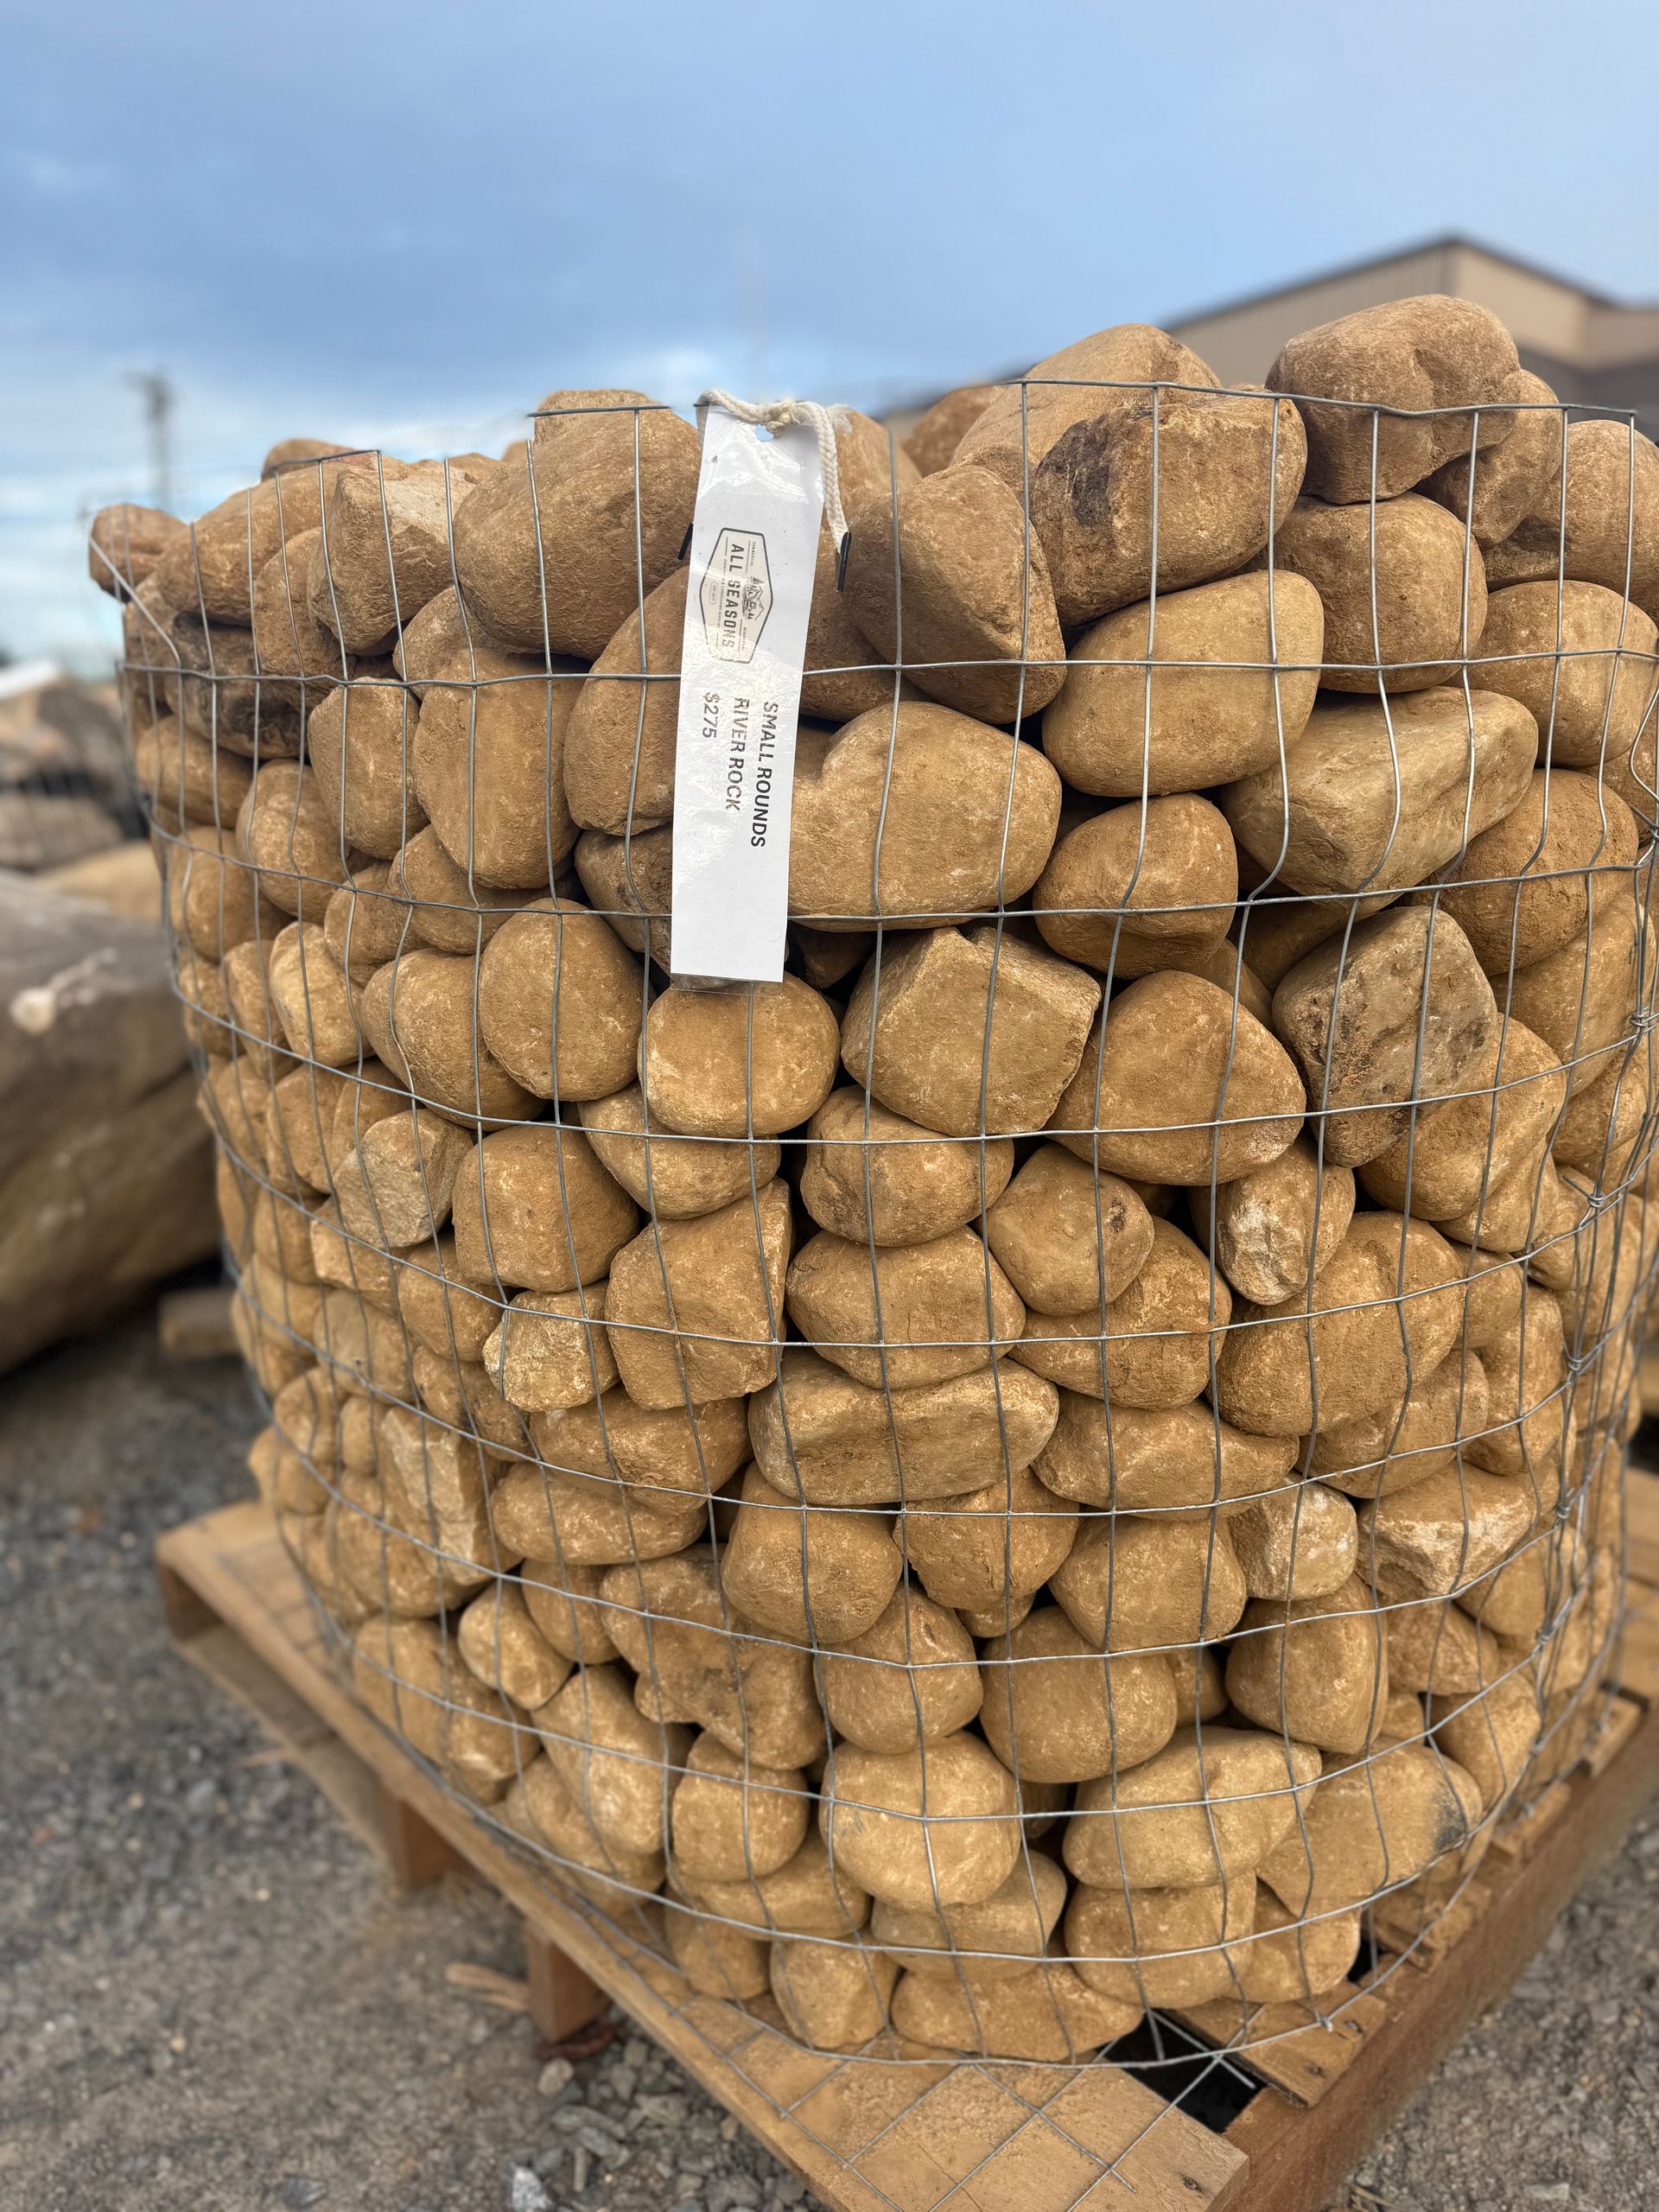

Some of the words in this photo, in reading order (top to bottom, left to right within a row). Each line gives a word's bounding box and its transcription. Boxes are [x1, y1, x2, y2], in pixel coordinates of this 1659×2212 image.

[729, 543, 745, 572] ALL
[721, 580, 741, 648] SEASONS
[702, 691, 722, 738] $275
[730, 697, 750, 753] RIVER
[758, 701, 779, 762] SMALL
[725, 757, 744, 811] ROCK
[751, 766, 772, 848] ROUNDS
